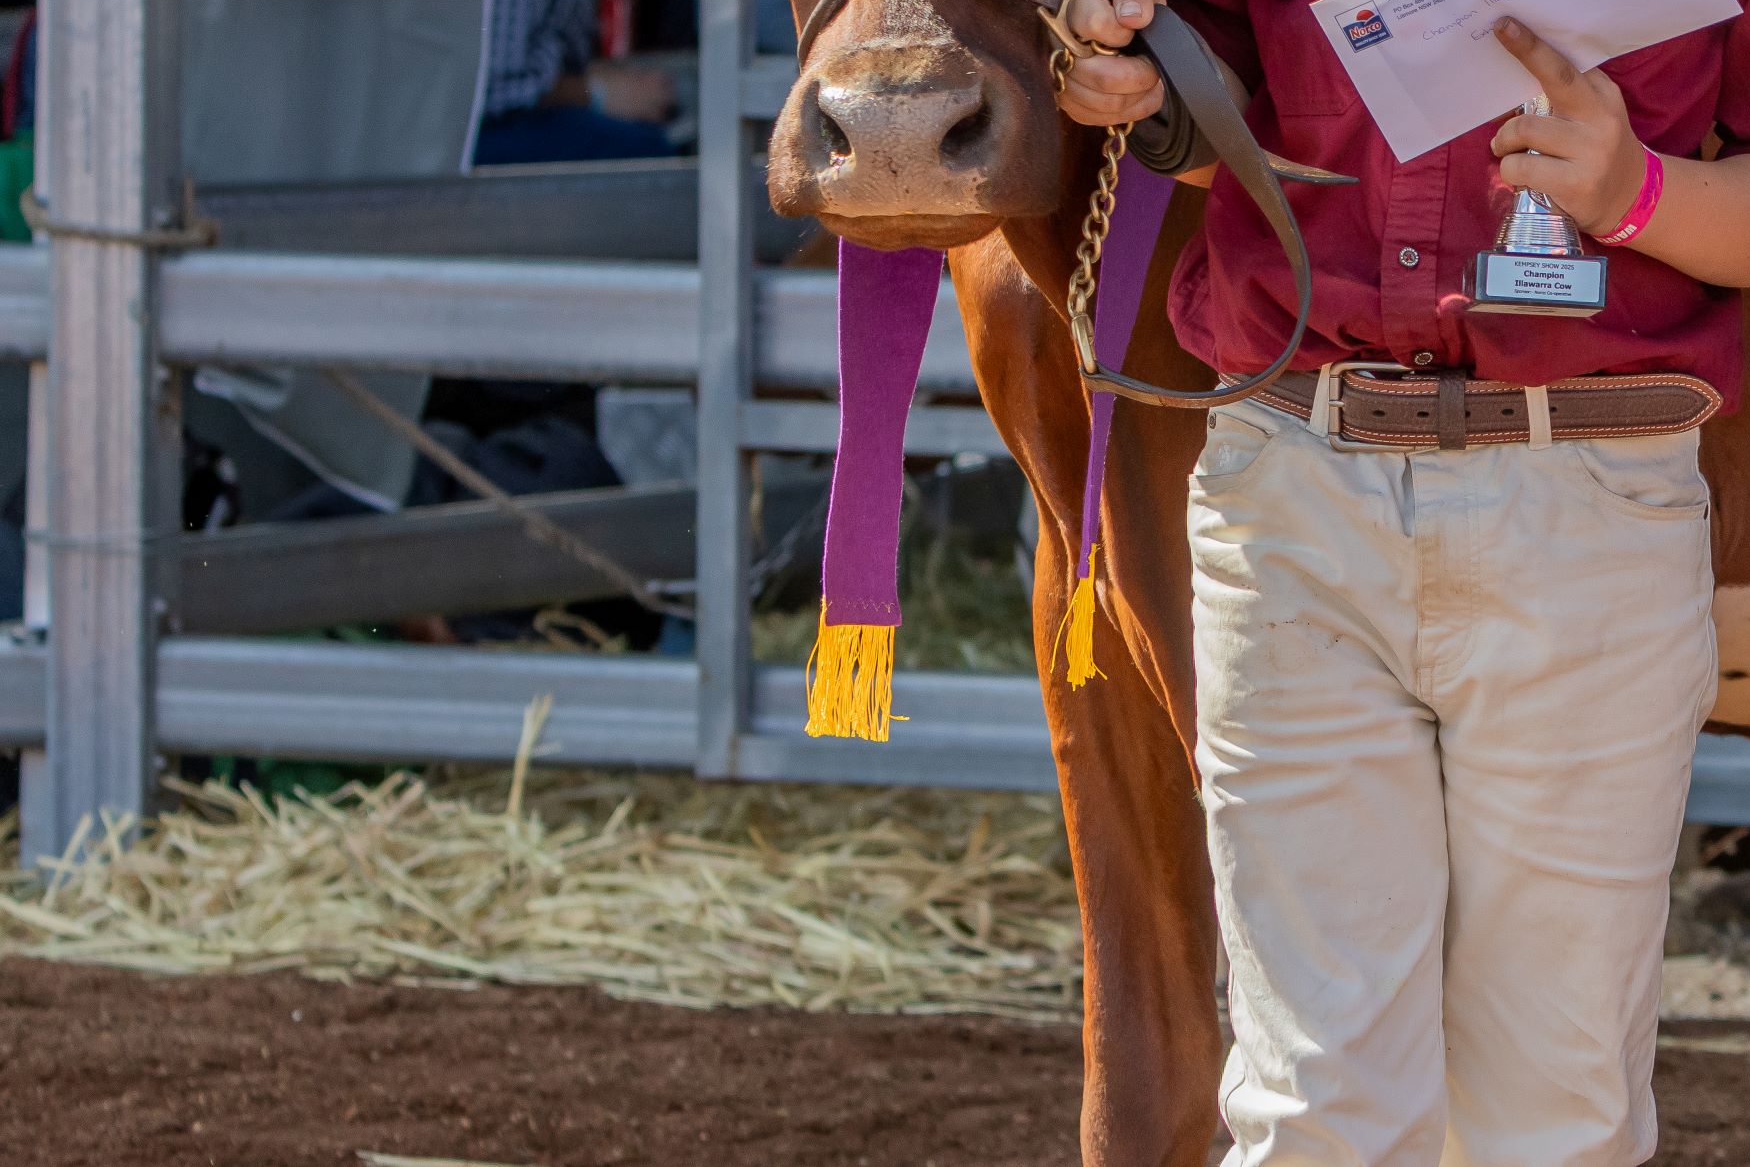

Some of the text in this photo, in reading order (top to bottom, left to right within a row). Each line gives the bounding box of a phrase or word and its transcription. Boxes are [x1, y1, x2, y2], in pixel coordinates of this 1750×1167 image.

[1349, 21, 1382, 41] Norco
[1422, 10, 1478, 40] Champion
[1523, 270, 1565, 280] Champion
[1514, 279, 1573, 290] Illawarra Cow
